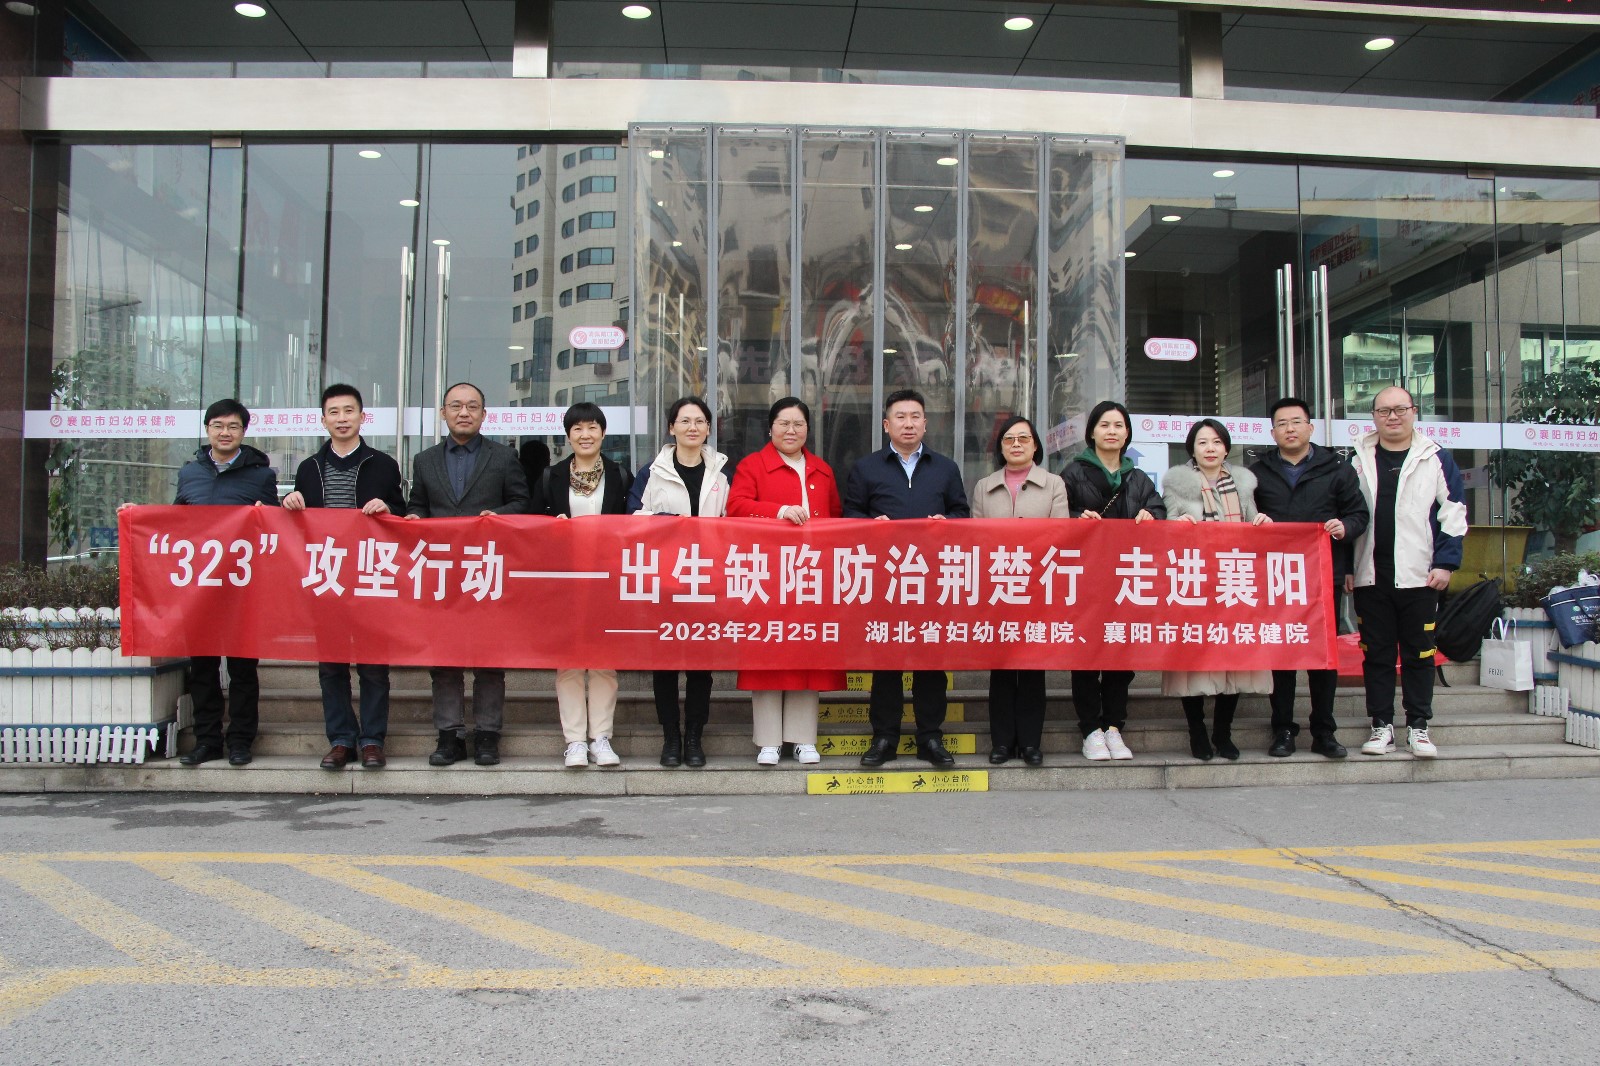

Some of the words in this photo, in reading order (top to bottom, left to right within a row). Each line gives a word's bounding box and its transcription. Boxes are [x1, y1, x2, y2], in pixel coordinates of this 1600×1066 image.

[67, 415, 176, 427] 襄阳市妇幼保健院
[1540, 429, 1598, 441] 襄阳市妇幼
[149, 533, 279, 587] “323”
[1114, 546, 1308, 608] 走进襄阳
[840, 738, 873, 746] 小心台
[846, 776, 884, 785] 小心台阶
[931, 775, 970, 783] 小心台阶
